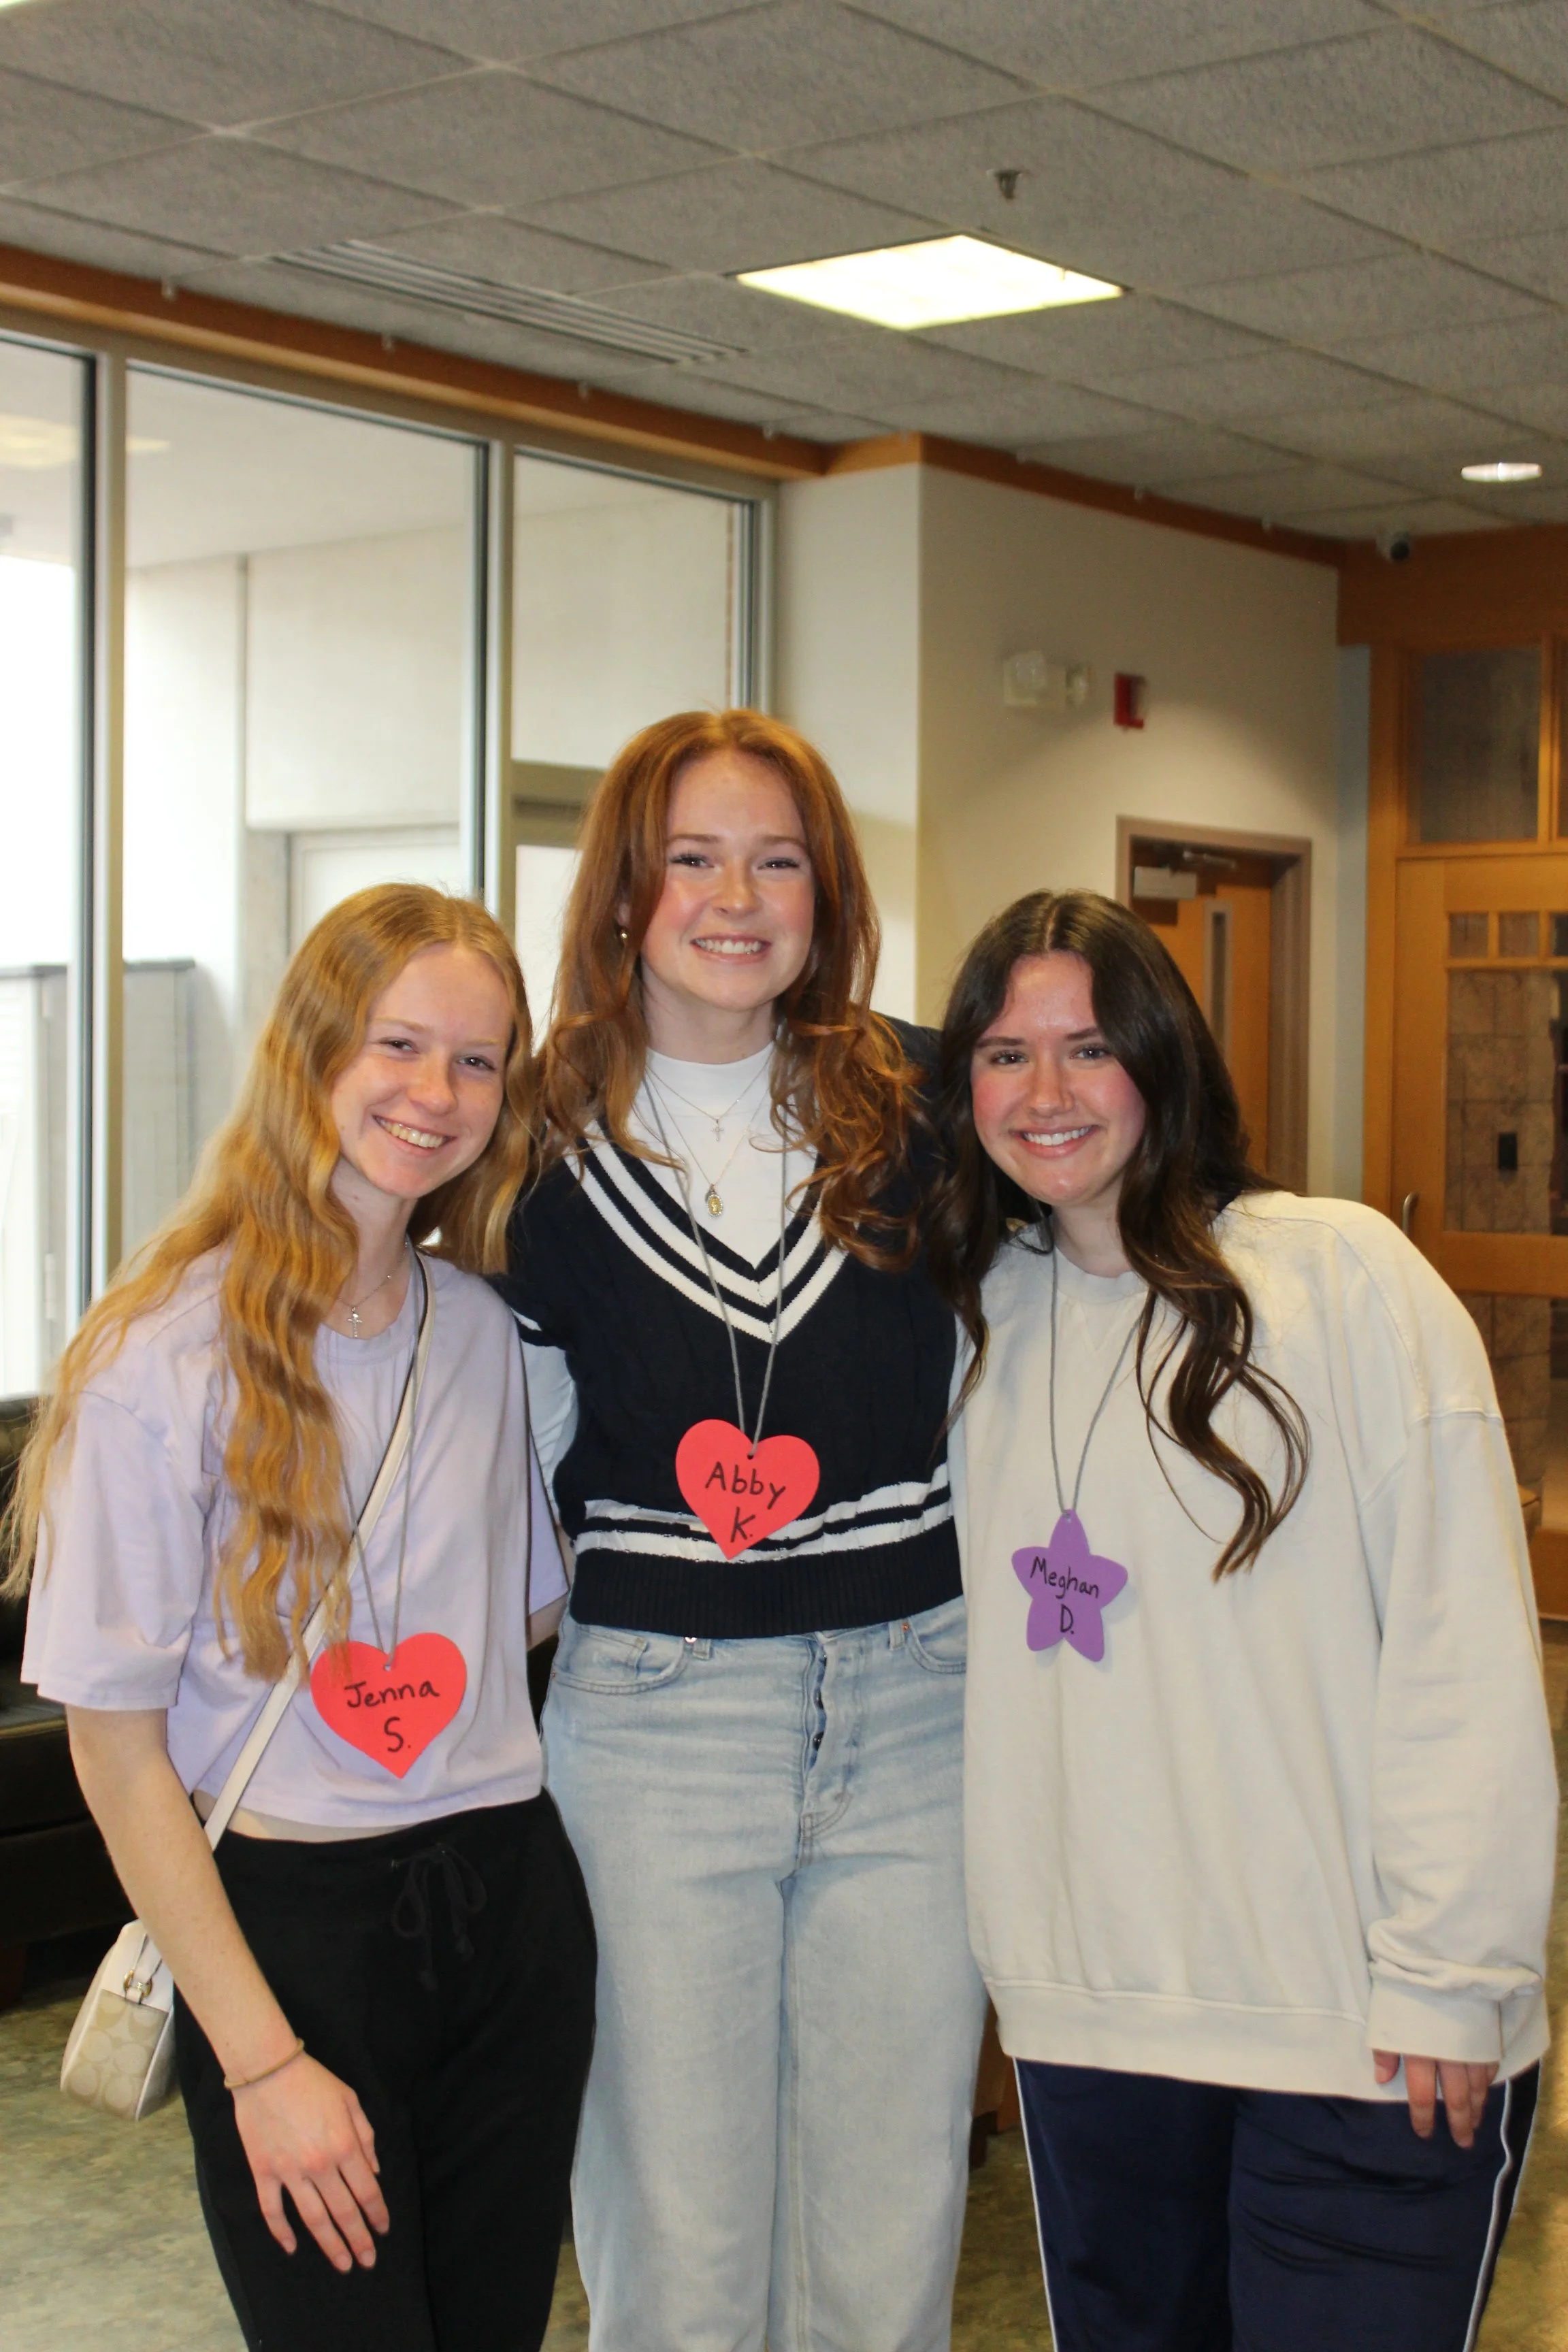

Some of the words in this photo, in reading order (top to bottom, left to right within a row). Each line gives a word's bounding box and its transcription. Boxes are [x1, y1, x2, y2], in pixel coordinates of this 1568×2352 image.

[705, 1461, 786, 1509] Abby
[730, 1506, 756, 1543] K.
[1030, 1556, 1099, 1599] Meghan
[1060, 1603, 1074, 1635] D.
[344, 1680, 440, 1708] Jenna
[384, 1716, 411, 1752] S.
